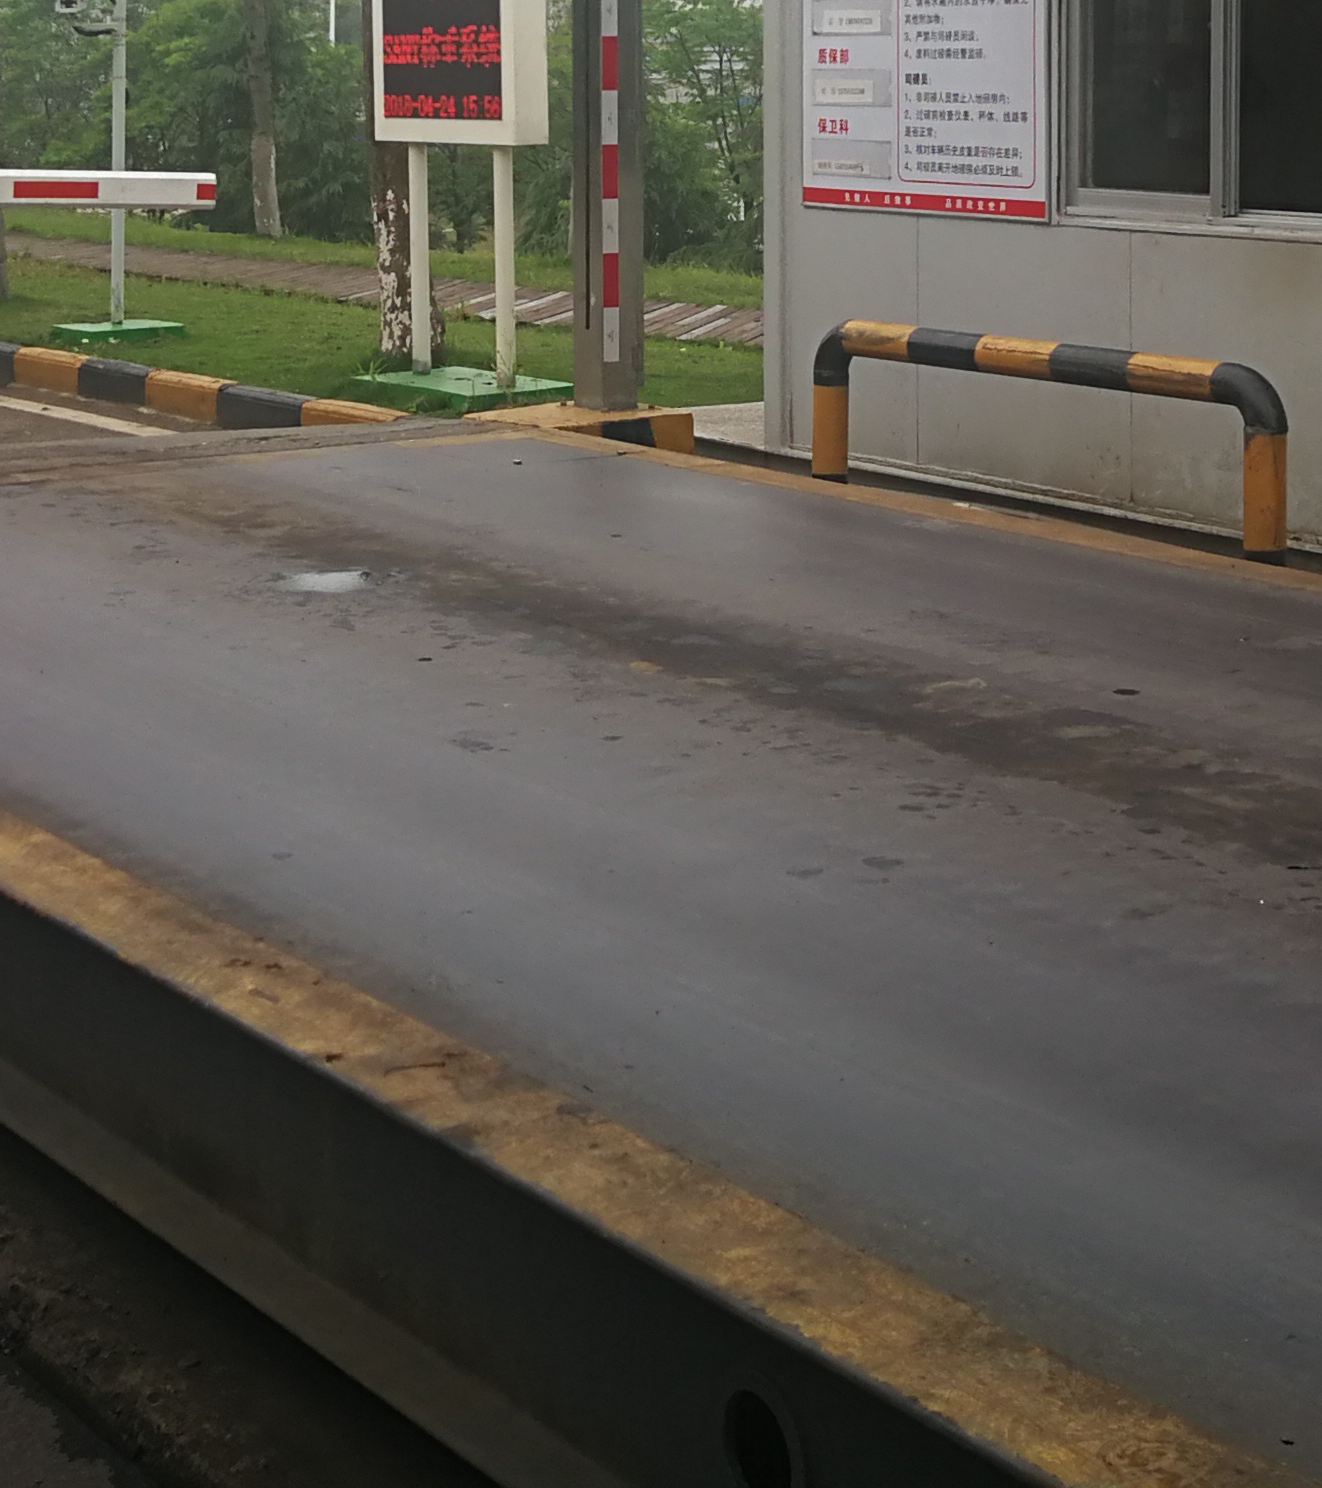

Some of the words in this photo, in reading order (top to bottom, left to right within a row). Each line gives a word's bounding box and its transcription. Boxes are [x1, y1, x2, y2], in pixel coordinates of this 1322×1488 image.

[817, 47, 850, 65] 质保部
[817, 118, 849, 135] 保卫科
